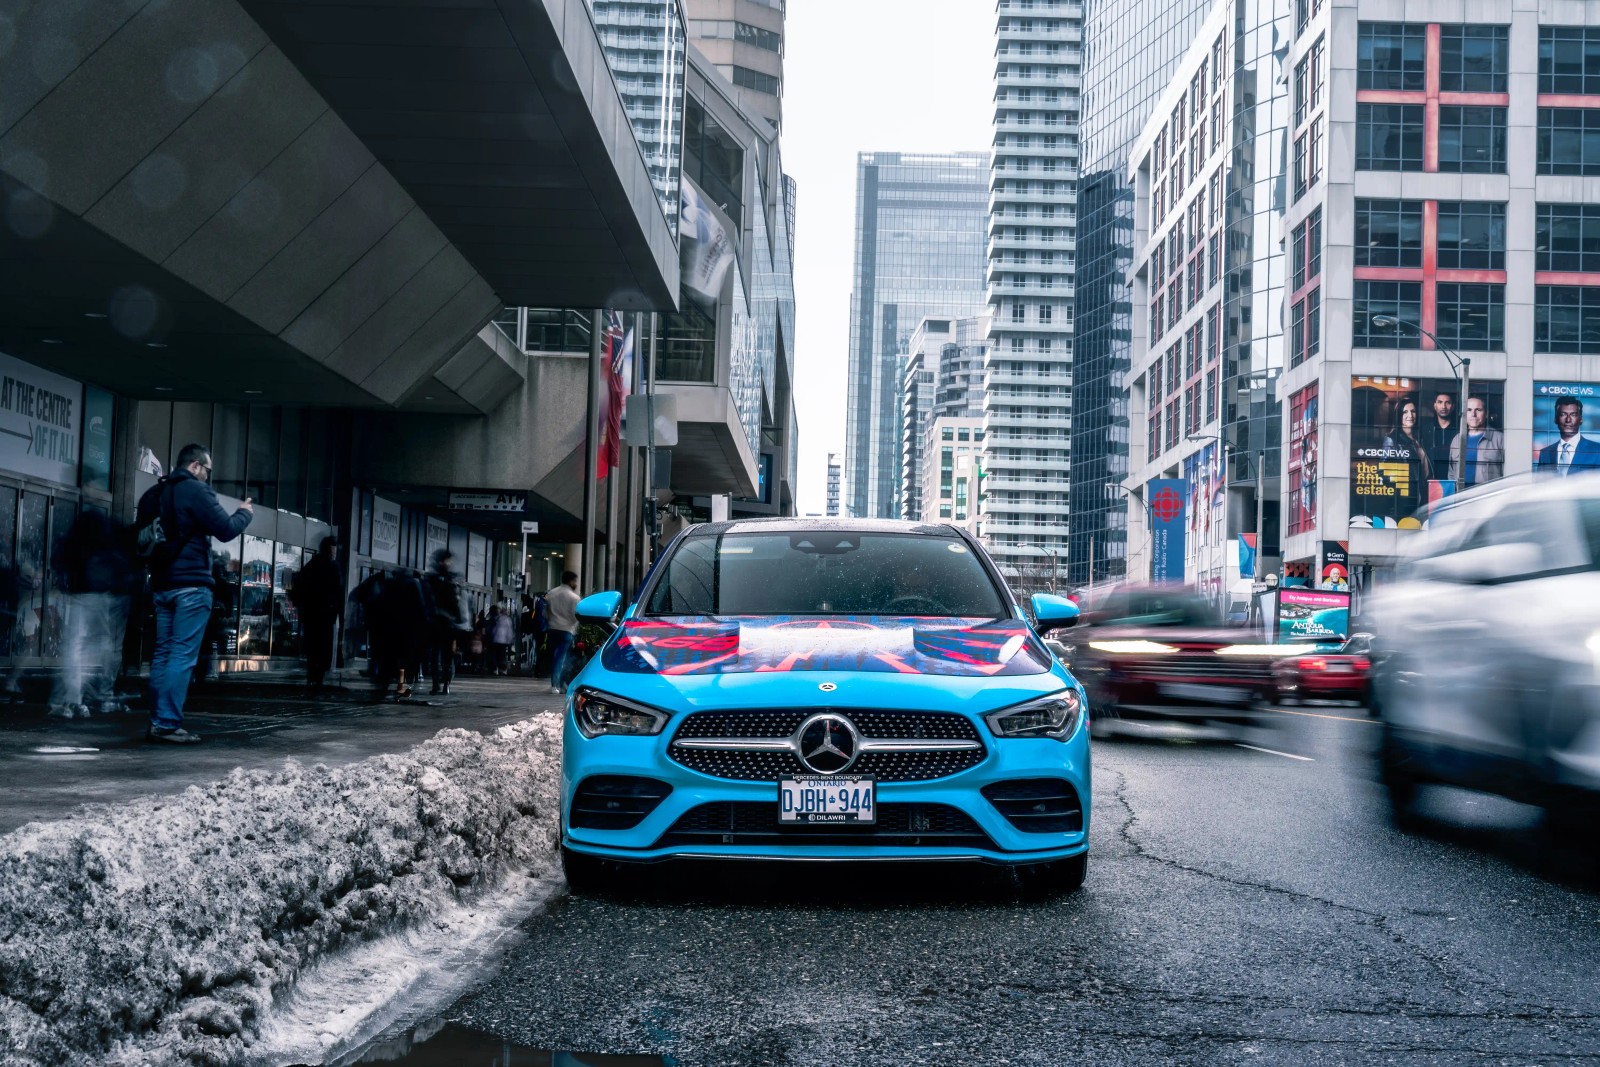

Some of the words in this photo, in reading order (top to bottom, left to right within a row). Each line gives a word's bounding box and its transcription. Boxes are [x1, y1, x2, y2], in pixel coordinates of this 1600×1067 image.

[0, 376, 14, 410] AT
[16, 380, 35, 418] THE
[36, 388, 73, 429] CENTRE
[34, 424, 48, 458] OF
[49, 429, 59, 461] IT
[59, 433, 76, 465] ALL
[1356, 461, 1378, 474] the
[1355, 473, 1384, 485] fifth
[1355, 485, 1395, 496] estate
[1292, 620, 1323, 629] ANTIGUA
[782, 788, 827, 813] DJBH
[838, 788, 872, 812] 944
